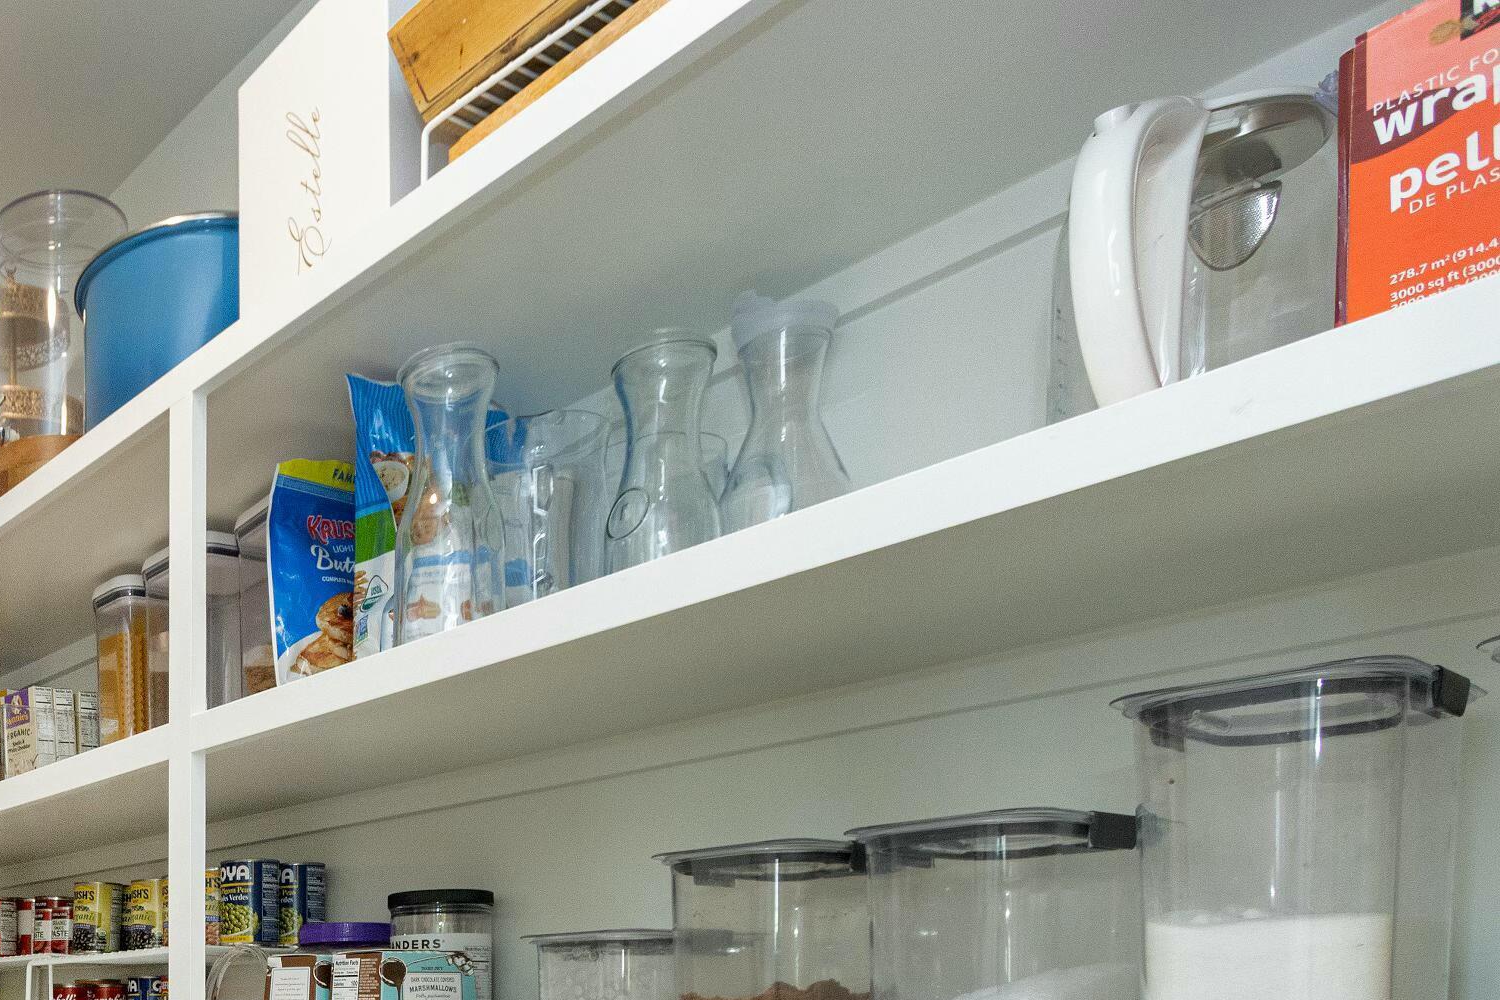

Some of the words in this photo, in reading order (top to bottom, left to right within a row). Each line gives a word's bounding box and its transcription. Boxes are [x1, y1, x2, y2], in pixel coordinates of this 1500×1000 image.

[1373, 65, 1460, 116] PLASTIC
[1373, 65, 1500, 145] wra
[286, 105, 333, 276] Estelle
[1409, 192, 1436, 215] DE
[1389, 263, 1428, 286] 278.7
[1389, 282, 1425, 302] 3000
[1427, 277, 1445, 289] sq
[1447, 270, 1460, 282] ft
[307, 514, 356, 544] KRUS
[220, 864, 250, 882] OYA
[74, 890, 95, 901] USH'S
[132, 888, 149, 900] SH'S
[409, 982, 458, 993] MARSHMALLOWS
